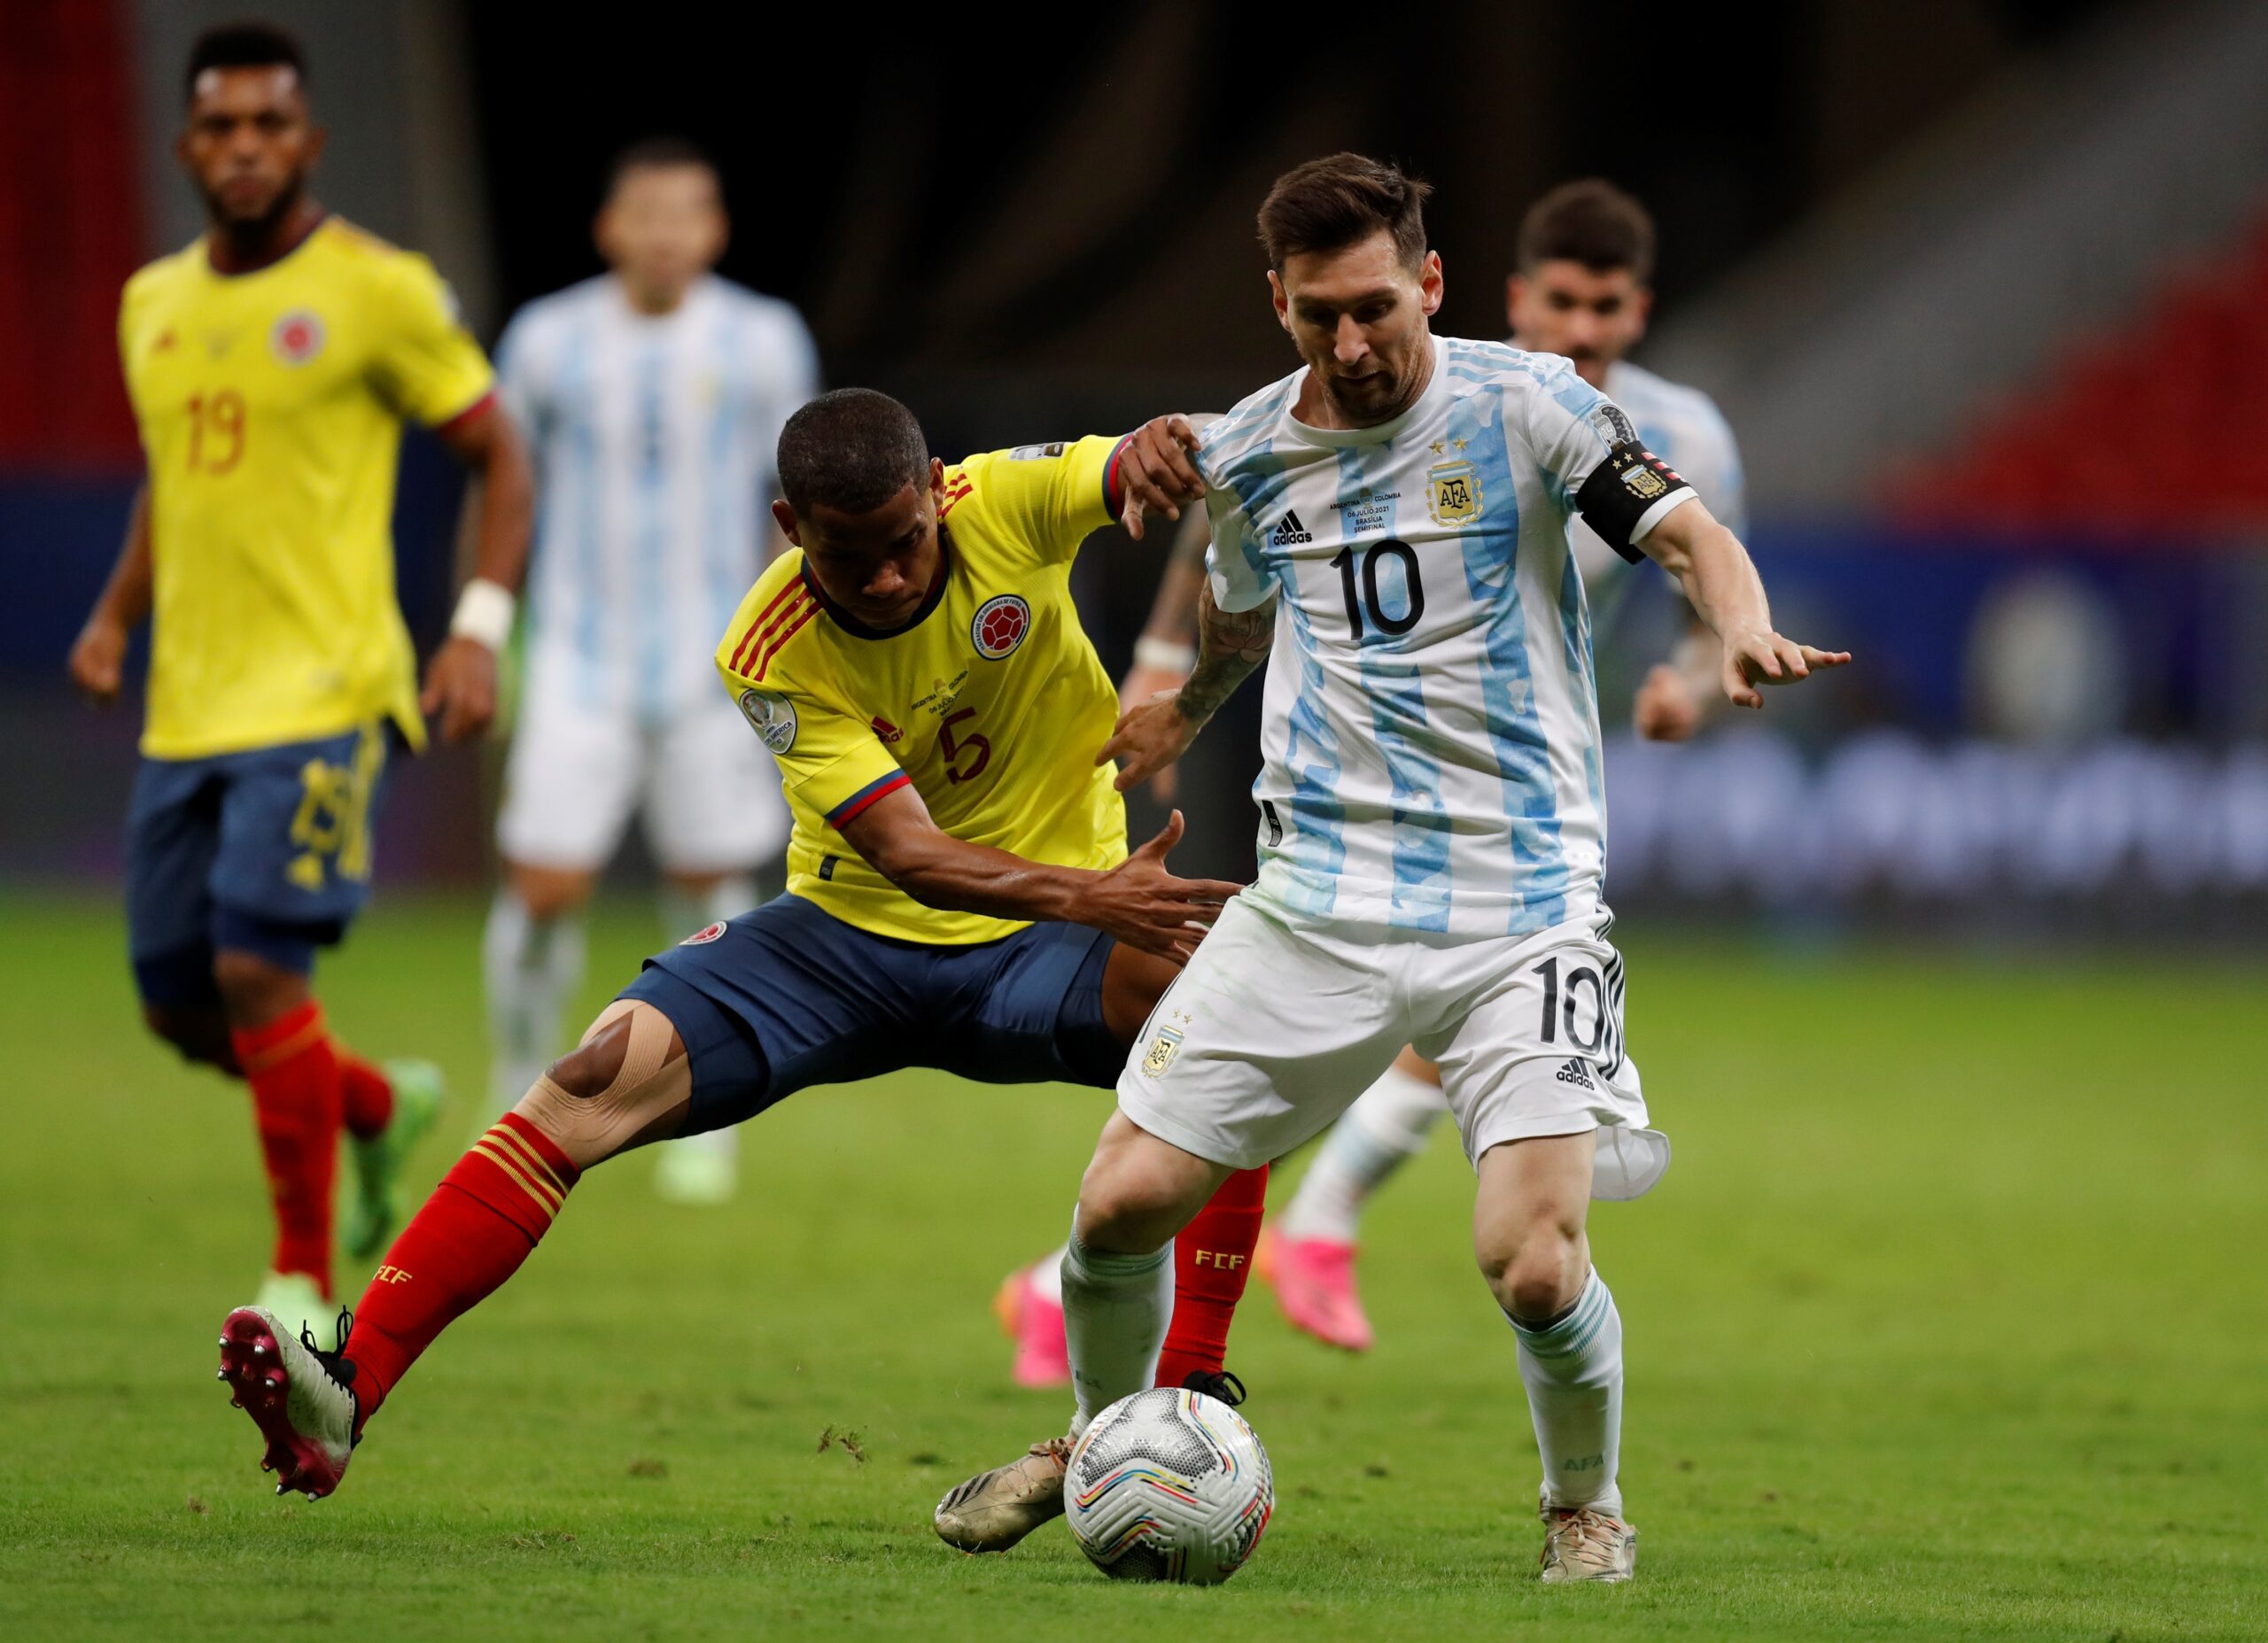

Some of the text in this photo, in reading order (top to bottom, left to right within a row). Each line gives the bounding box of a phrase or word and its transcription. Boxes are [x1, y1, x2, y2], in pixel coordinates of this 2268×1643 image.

[185, 390, 245, 477] 19
[1330, 492, 1402, 510] ARGENTINA COLOMBIA
[1440, 479, 1471, 509] AFA
[1355, 508, 1374, 517] JULIO
[1375, 505, 1389, 515] 2021
[1273, 531, 1313, 546] adidas
[1354, 523, 1386, 533] SEMIFINAL
[1329, 539, 1425, 640] 10
[937, 706, 990, 786] 5
[1530, 956, 1605, 1057] 10
[1150, 1038, 1171, 1065] AFA
[1556, 1069, 1596, 1091] adidas
[1195, 1249, 1245, 1270] FCF
[372, 1265, 413, 1284] FCF
